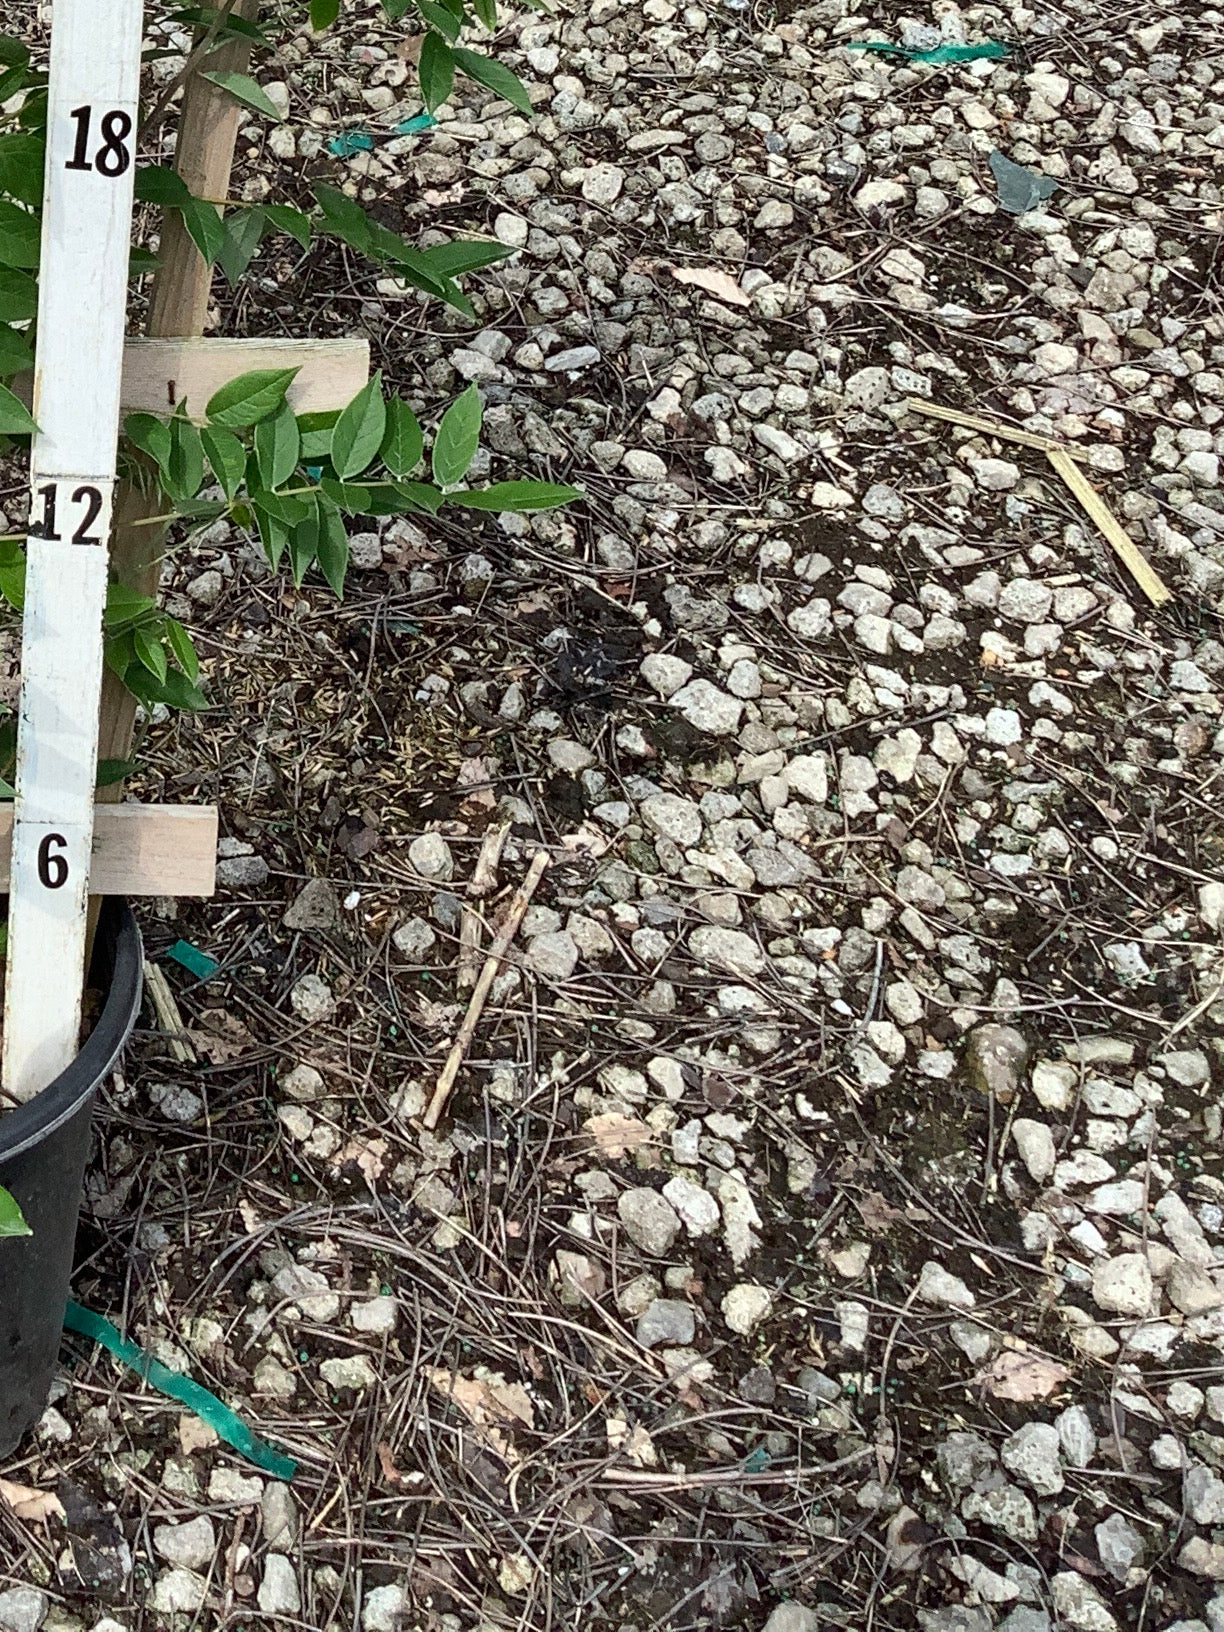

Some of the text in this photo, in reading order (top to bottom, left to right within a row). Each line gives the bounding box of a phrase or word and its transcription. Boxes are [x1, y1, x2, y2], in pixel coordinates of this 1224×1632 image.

[64, 105, 132, 177] 18
[37, 483, 102, 546] 12
[38, 833, 69, 889] 6
